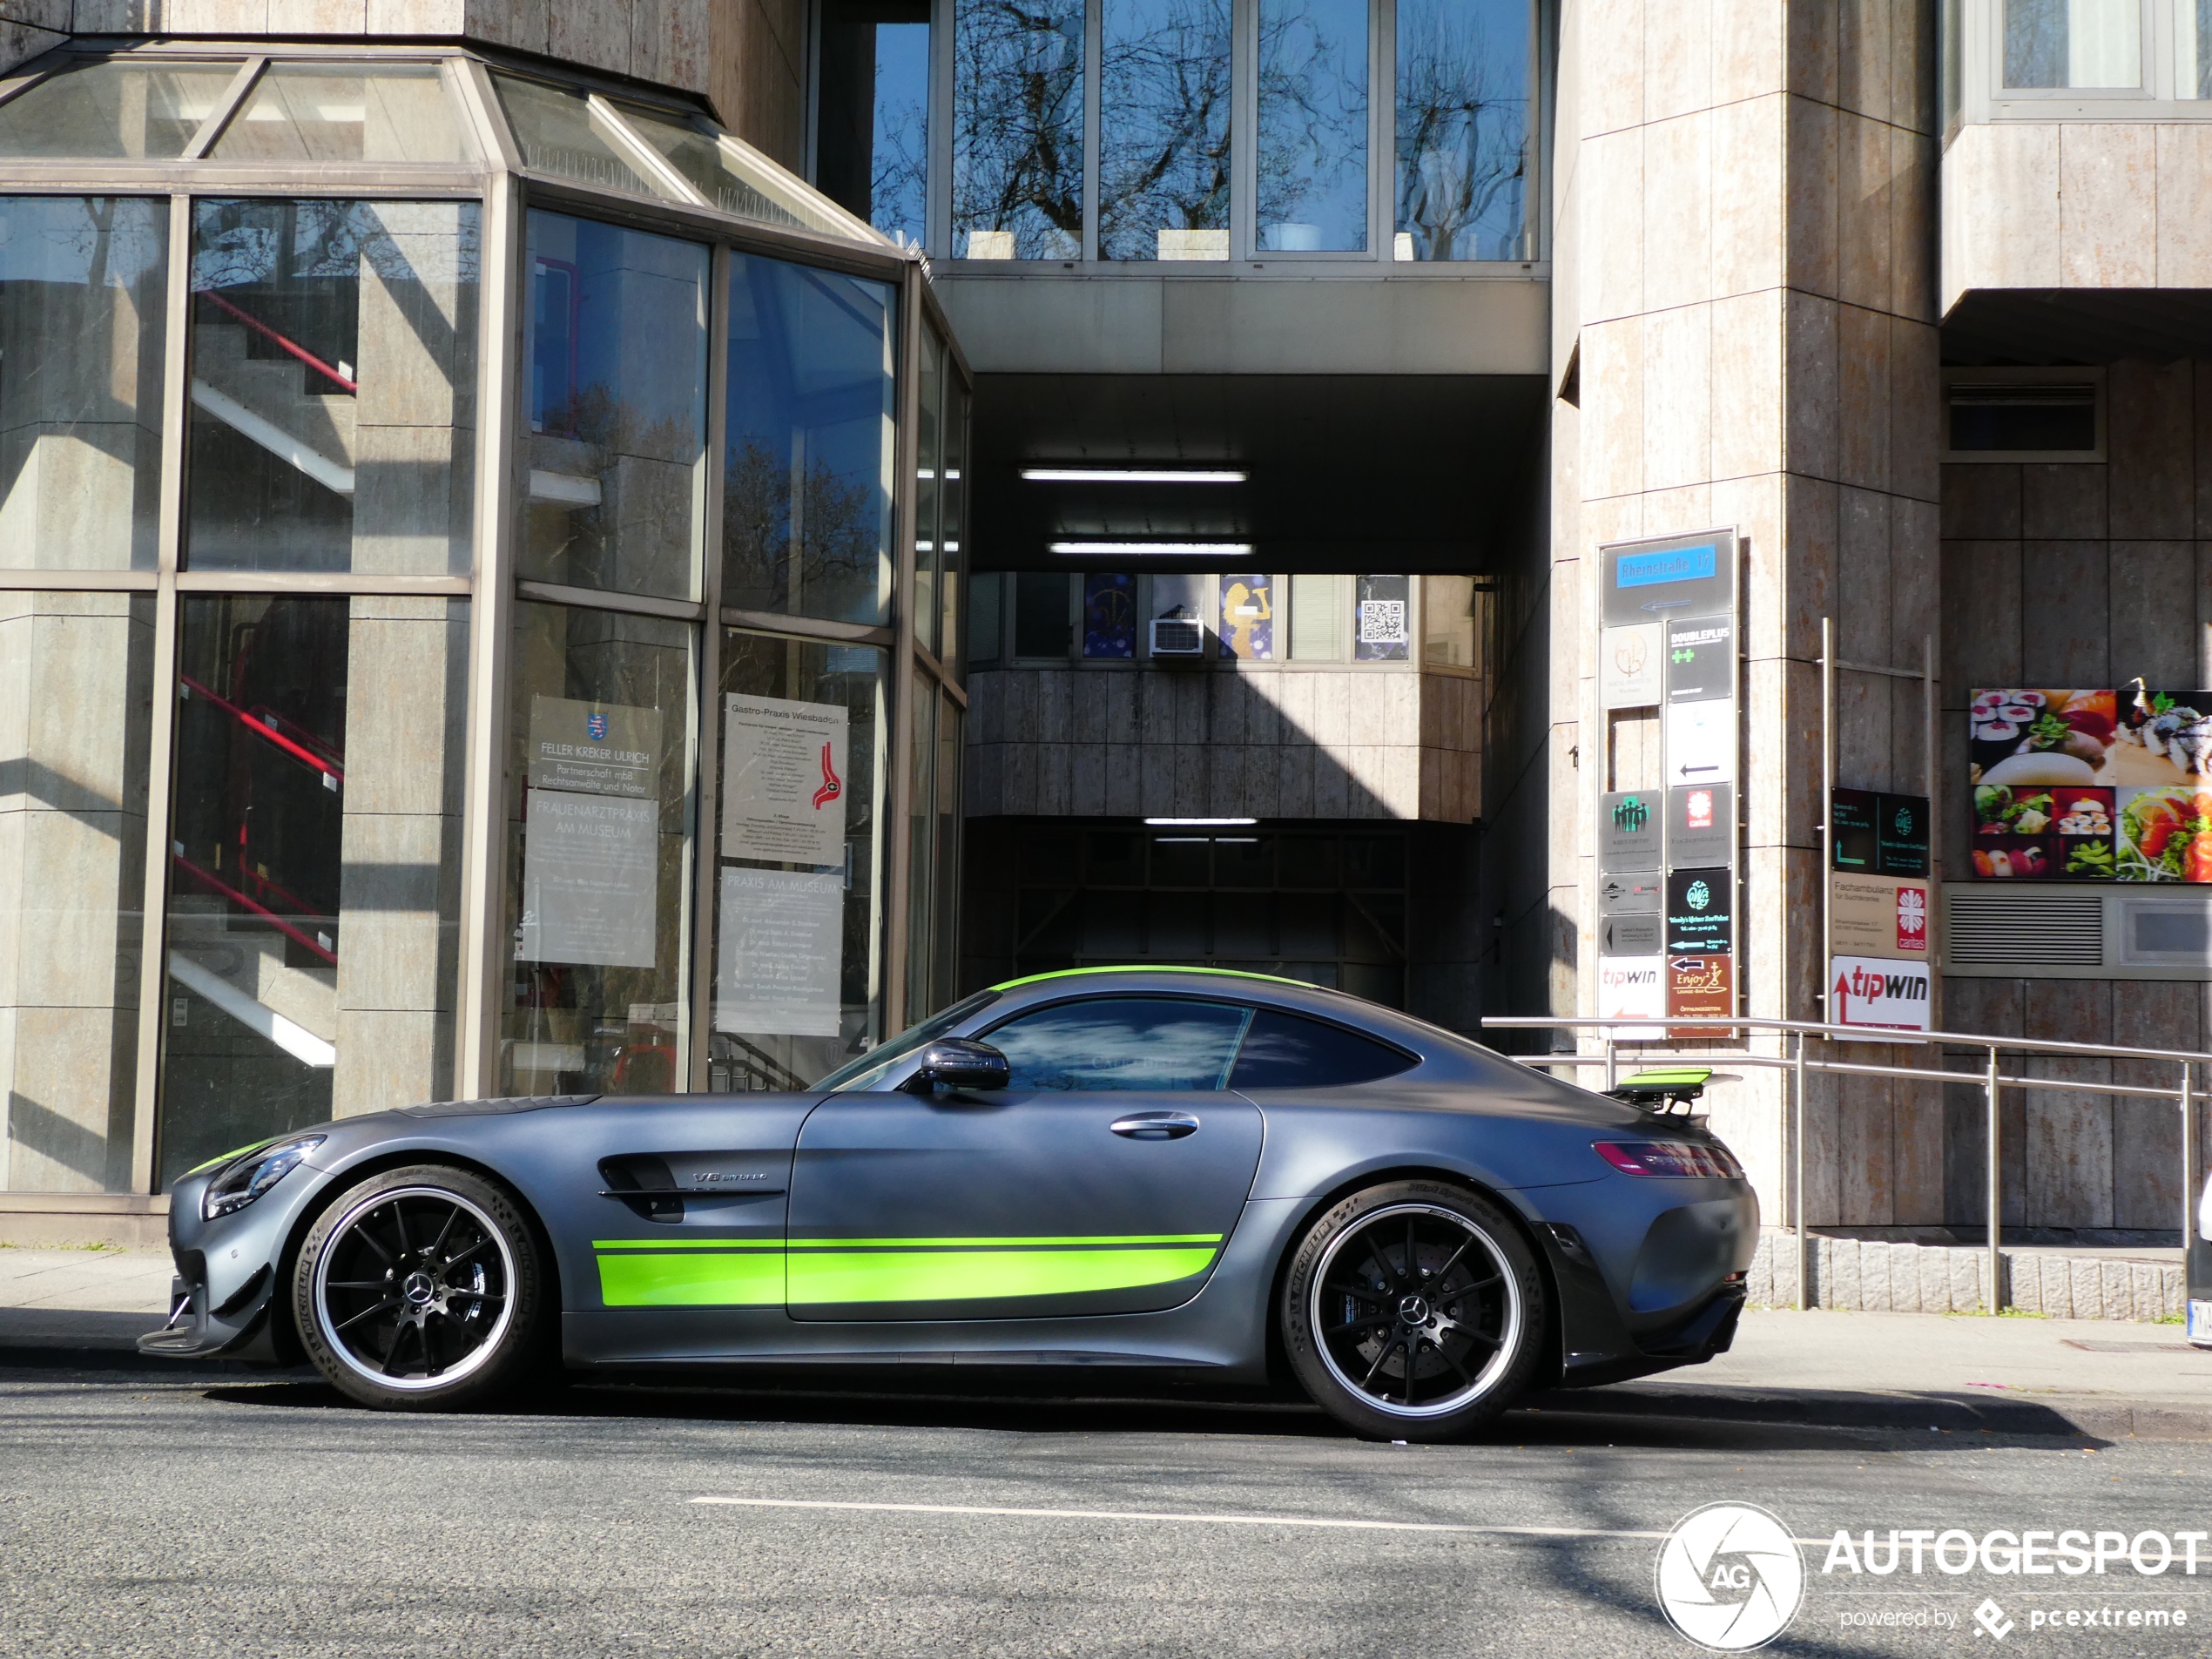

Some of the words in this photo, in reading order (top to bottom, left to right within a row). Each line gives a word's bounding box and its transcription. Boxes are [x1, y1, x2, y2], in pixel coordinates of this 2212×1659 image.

[1622, 558, 1689, 578] Rheinstraße
[1697, 554, 1710, 569] 17
[1671, 628, 1730, 643] DOUBLEPLUS
[732, 704, 790, 719] Gastro-Praxis
[792, 712, 839, 724] Wiesbaden
[541, 742, 573, 756] FELLER
[576, 746, 611, 760] KREKER
[614, 751, 649, 763] ULRICH
[557, 765, 612, 779] Partnerschaft
[615, 771, 633, 781] mbB
[542, 775, 601, 790] Rechtsanwälte
[623, 784, 645, 794] Notar
[536, 801, 650, 823] FRAUENARZTPRAXIS
[555, 823, 574, 834] AM
[578, 824, 631, 839] MUSEUM
[1672, 835, 1726, 844] Fachambulanz
[727, 875, 764, 889] PRAXIS
[768, 879, 785, 890] AM
[789, 880, 838, 894] MUSEUM
[1835, 882, 1894, 895] Fachambulanz
[1845, 894, 1880, 903] Suchtkranke
[1899, 938, 1925, 949] caritas
[1603, 968, 1656, 988] tipwin
[1852, 965, 1927, 1005] tipwin
[693, 1172, 720, 1182] V8
[722, 1173, 768, 1182] BITURBO
[1408, 1183, 1439, 1194] Pilot
[1438, 1187, 1473, 1205] Sport
[1291, 1221, 1334, 1294] MICHELIN
[297, 1260, 313, 1334] MICHELIN
